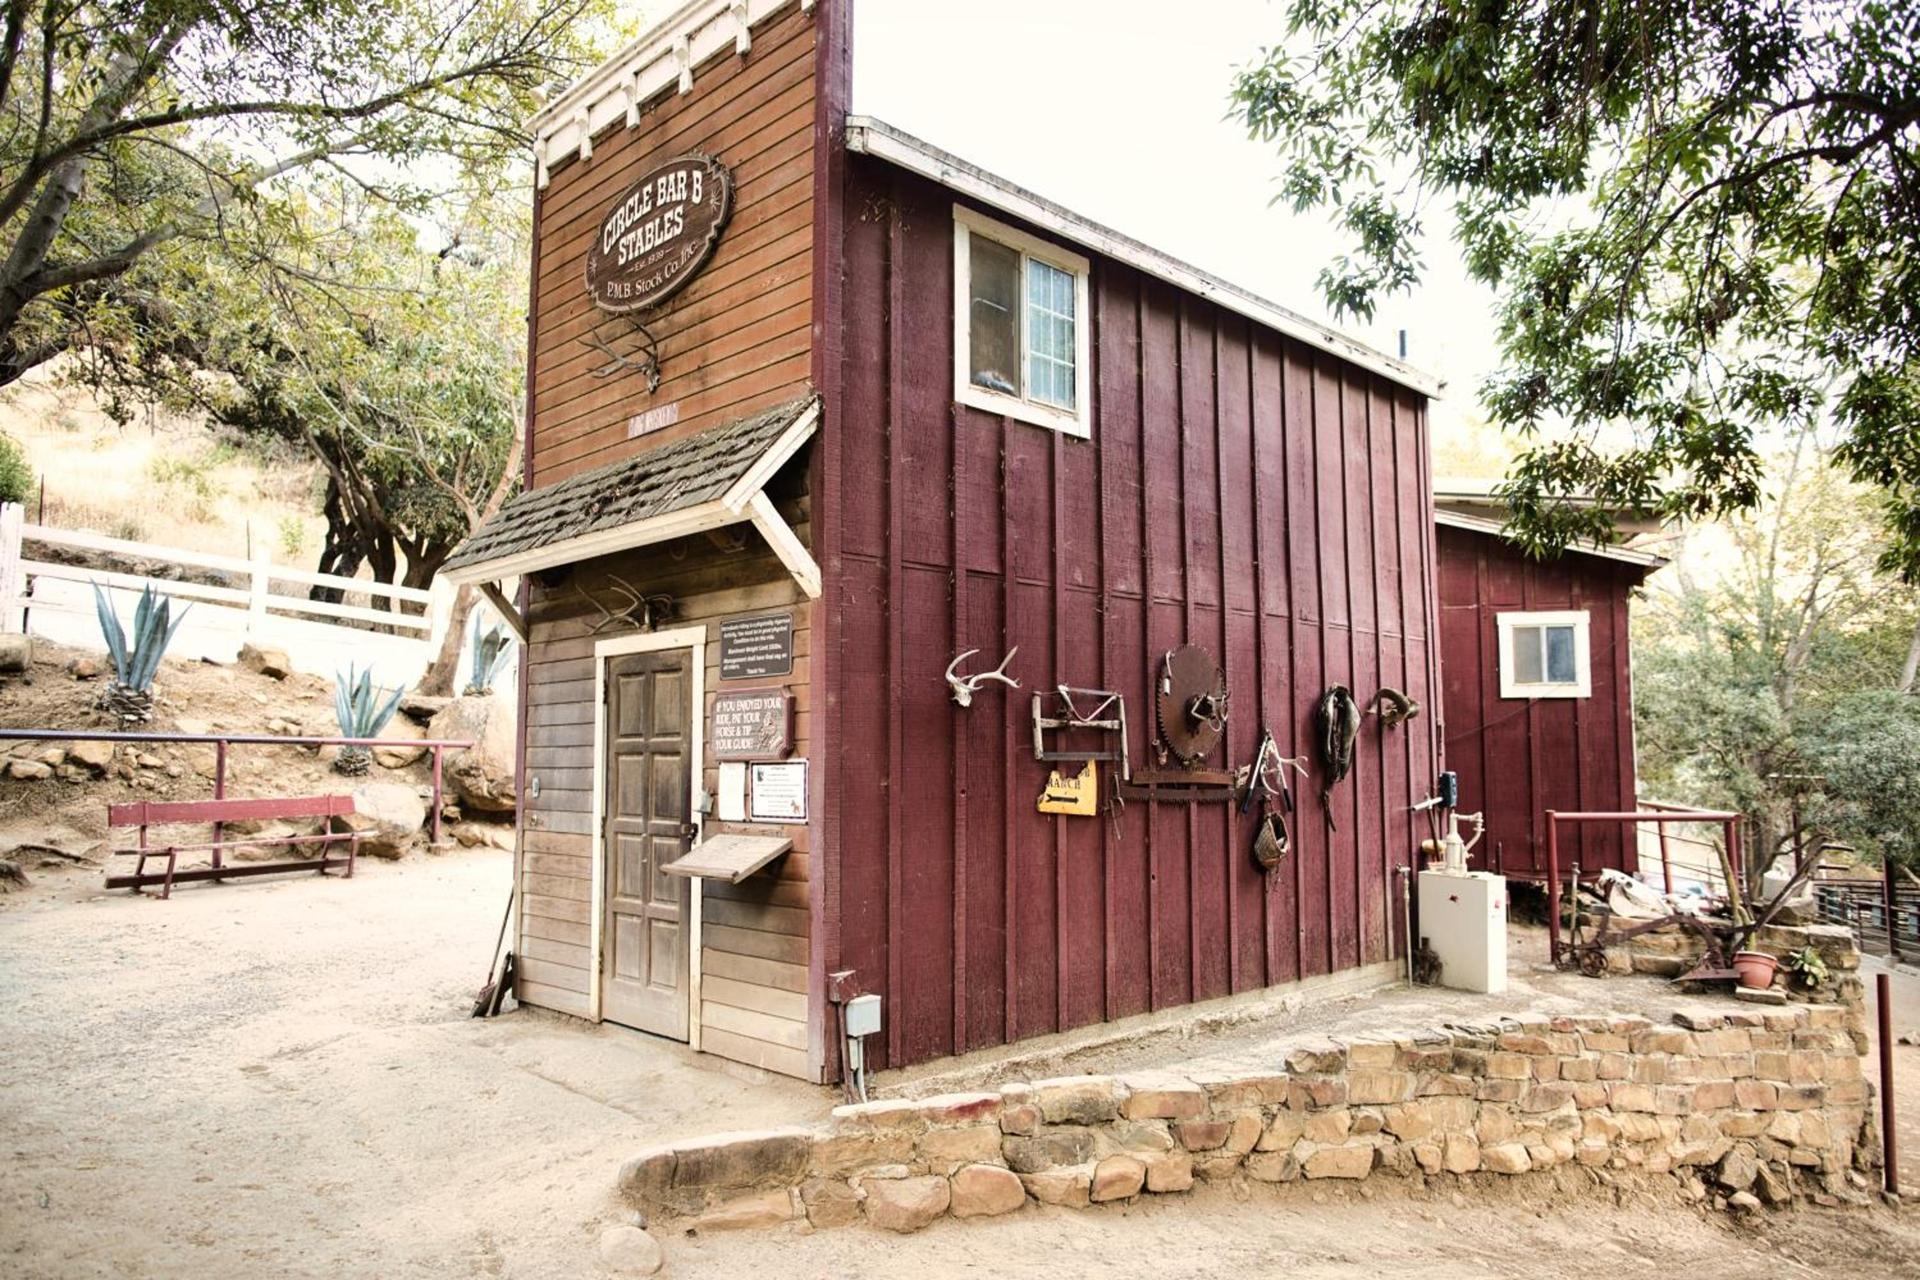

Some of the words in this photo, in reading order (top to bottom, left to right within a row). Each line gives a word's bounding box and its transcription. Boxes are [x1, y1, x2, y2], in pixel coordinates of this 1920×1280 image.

[603, 183, 652, 255] CIRCLE
[656, 170, 687, 207] BAR
[692, 170, 703, 204] B
[618, 205, 684, 266] STABLES
[635, 271, 663, 295] Stock
[716, 702, 721, 712] IF
[722, 701, 735, 712] YOU
[736, 698, 763, 712] ENJOYED
[763, 697, 782, 709] YOUR
[743, 712, 761, 723] YOUR
[715, 726, 735, 737] HORSE
[742, 725, 752, 736] TIP
[715, 738, 732, 750] YOUR
